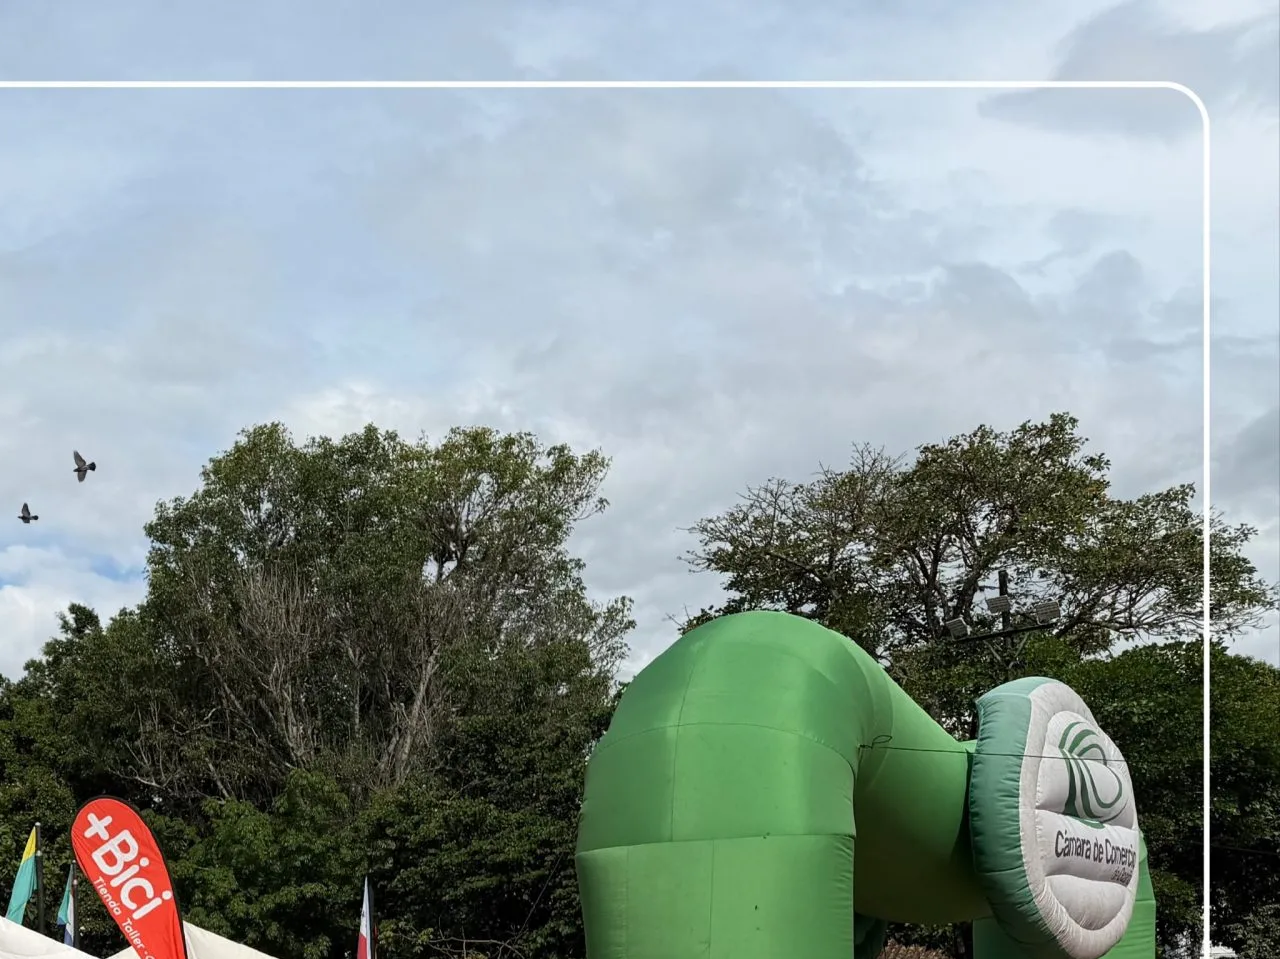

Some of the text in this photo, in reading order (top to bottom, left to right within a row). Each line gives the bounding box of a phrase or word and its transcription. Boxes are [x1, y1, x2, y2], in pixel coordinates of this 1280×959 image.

[84, 813, 172, 920] +Bici
[1055, 829, 1091, 860] Cámara
[1093, 837, 1104, 863] de
[93, 876, 122, 916] Tienda
[122, 918, 145, 949] Taller
